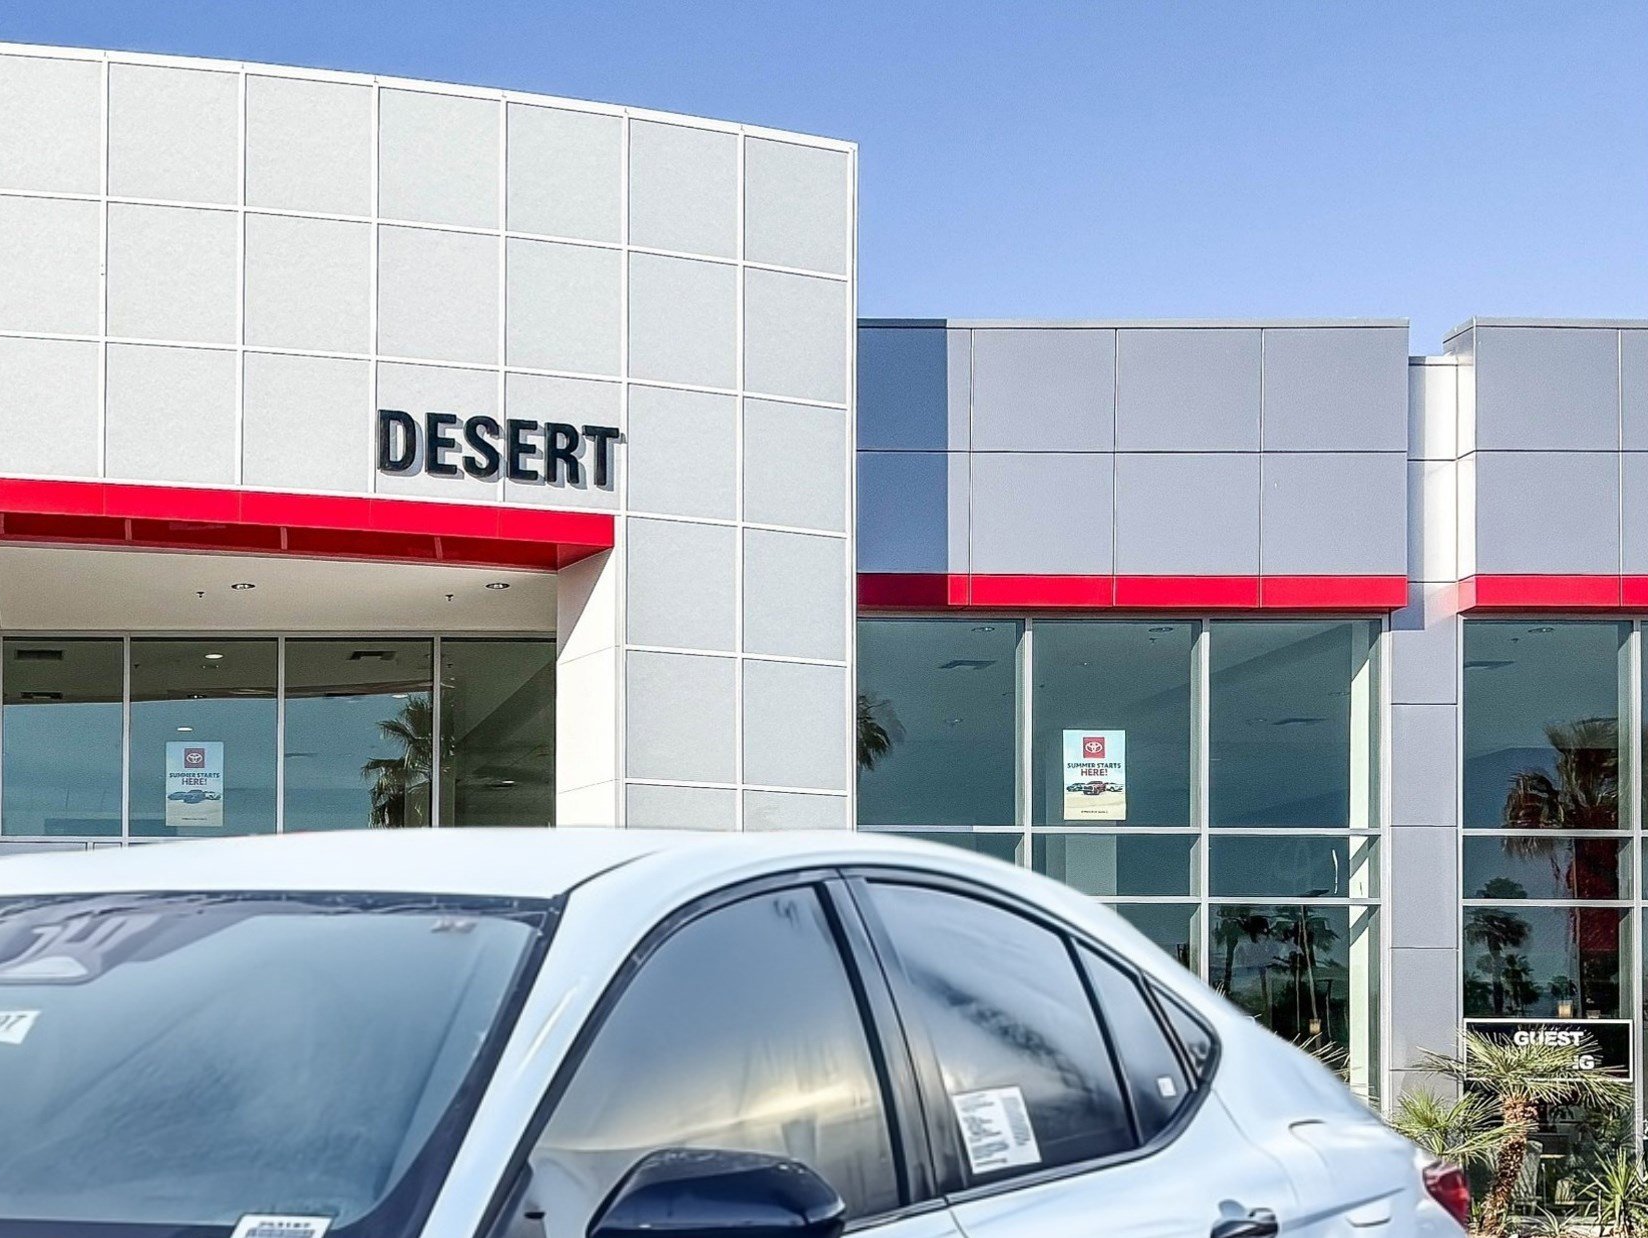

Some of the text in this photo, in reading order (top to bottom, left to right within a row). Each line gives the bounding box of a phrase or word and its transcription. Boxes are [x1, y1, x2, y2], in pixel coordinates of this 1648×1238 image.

[377, 409, 620, 487] DESERT
[1080, 768, 1108, 777] HERE!
[181, 778, 208, 786] HERE!
[1513, 1031, 1584, 1047] GUEST
